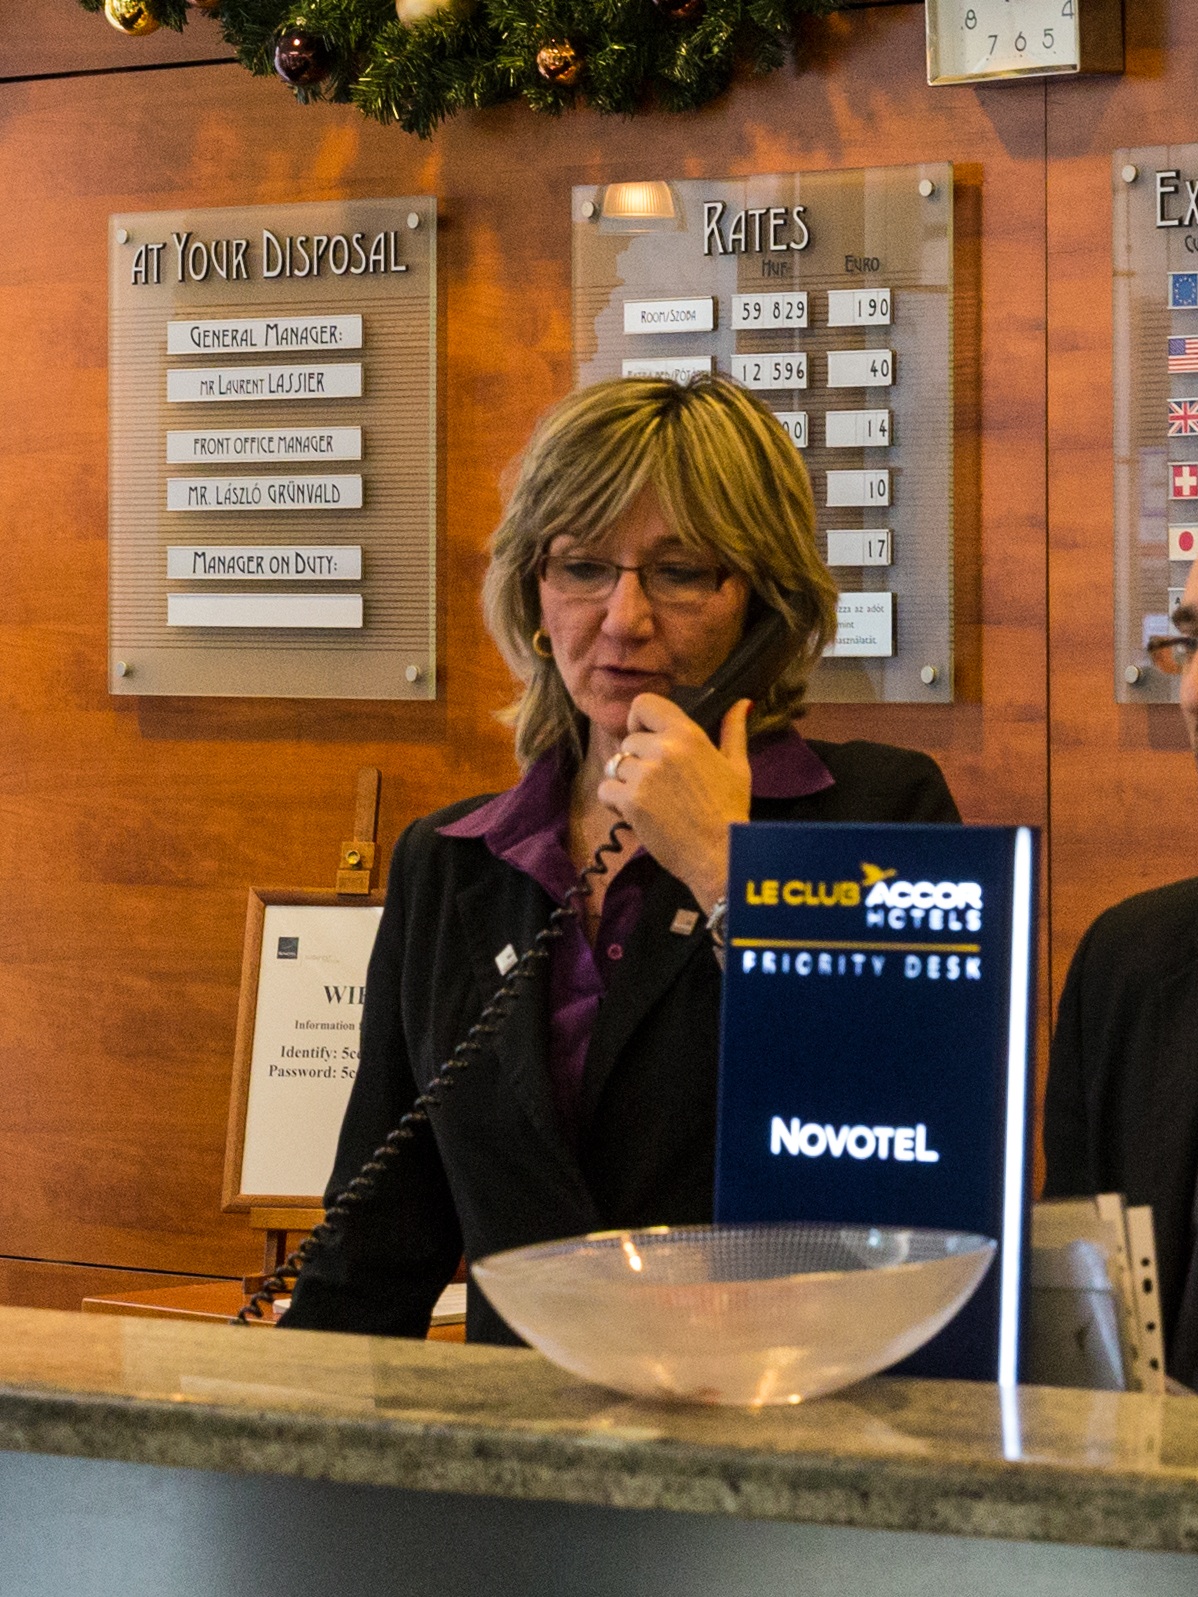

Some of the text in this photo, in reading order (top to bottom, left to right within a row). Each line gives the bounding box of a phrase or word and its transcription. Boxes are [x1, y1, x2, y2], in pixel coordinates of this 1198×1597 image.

[965, 9, 977, 30] 8
[987, 28, 1054, 55] 7 6 5
[703, 201, 811, 255] RATES
[131, 229, 407, 285] AT YOUR DISPOSAL
[845, 255, 880, 273] EURO
[857, 299, 889, 317] 190
[190, 323, 343, 348] GENERAL MANAGER:
[870, 360, 890, 377] 40
[218, 374, 265, 395] LAURENT
[268, 372, 325, 394] LASSIER
[868, 419, 887, 438] 14
[193, 435, 333, 455] FRONT OFFICE MANAGER
[188, 480, 341, 506] MR. LÁSZLÓ GRÜNVALD
[869, 478, 887, 498] 10
[868, 540, 886, 558] 17
[193, 551, 337, 574] MANAGER ON DUTY:
[865, 880, 984, 910] ACCOR
[866, 909, 982, 931] HOTELS
[742, 950, 982, 980] PRIORITY DESK
[295, 1020, 355, 1031] Information
[281, 1045, 337, 1062] Identify:
[269, 1064, 337, 1079] Password:
[770, 1116, 940, 1163] NOVOTEL
